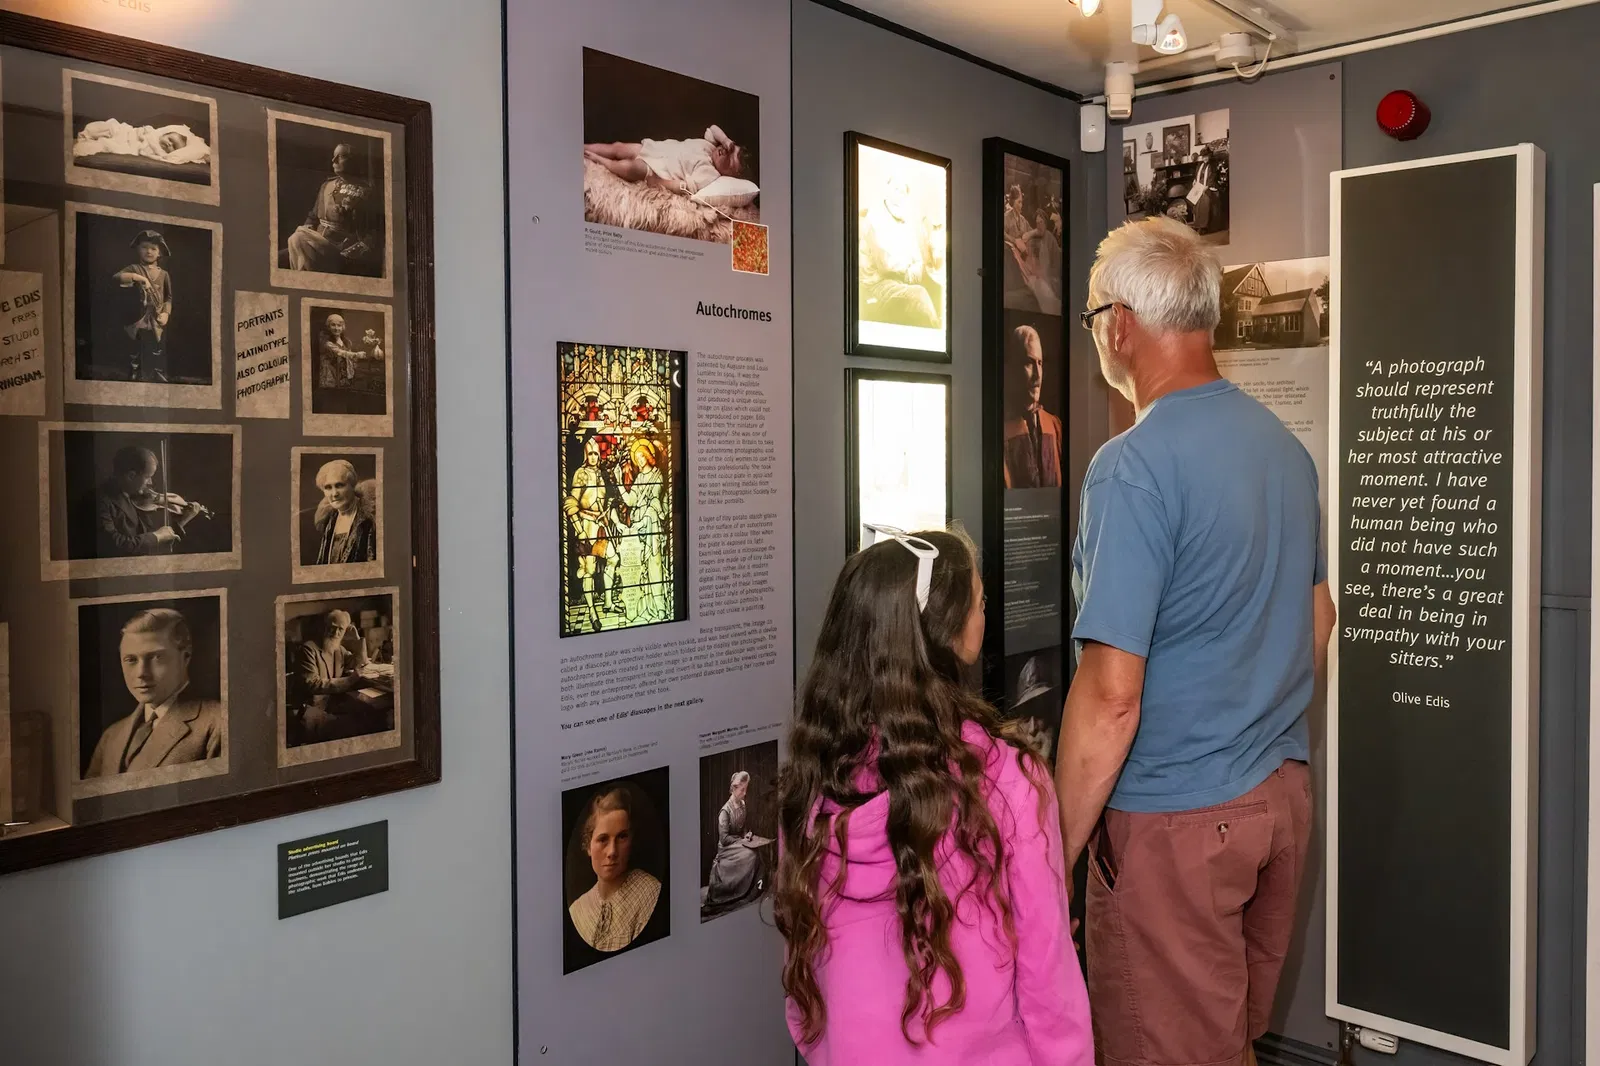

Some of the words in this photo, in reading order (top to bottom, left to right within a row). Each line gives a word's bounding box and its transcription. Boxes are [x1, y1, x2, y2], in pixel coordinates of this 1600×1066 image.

[14, 290, 41, 308] EDIS
[237, 308, 284, 332] PORTRAITS
[696, 301, 771, 322] Autochromes
[2, 328, 39, 345] STUDIO
[265, 328, 275, 337] IN
[237, 366, 256, 380] ALSO
[257, 355, 288, 373] COLOUR
[1388, 356, 1484, 378] photograph
[1356, 382, 1409, 397] should
[1416, 381, 1494, 399] represent
[1372, 404, 1443, 422] truthfully
[1450, 403, 1476, 418] the
[1358, 427, 1414, 444] subject
[1420, 428, 1436, 441] at
[1443, 426, 1466, 440] his
[1474, 430, 1492, 440] or
[1348, 449, 1373, 463] her
[1378, 451, 1417, 463] most
[1424, 449, 1502, 464] attractive
[1360, 473, 1427, 486] moment.
[1436, 472, 1441, 486] I
[1448, 472, 1487, 487] have
[1352, 497, 1395, 508] never
[1400, 496, 1425, 511] yet
[1431, 494, 1480, 512] found
[1487, 500, 1496, 510] a
[1351, 515, 1402, 530] human
[1410, 516, 1455, 536] being
[1464, 519, 1497, 534] who
[1351, 537, 1375, 551] did
[1381, 540, 1407, 553] not
[1414, 539, 1452, 555] have
[1458, 542, 1497, 557] such
[1361, 563, 1370, 573] a
[1345, 584, 1374, 598] see,
[1382, 582, 1435, 599] there’s
[1443, 590, 1452, 600] a
[1458, 591, 1504, 605] great
[1360, 603, 1392, 618] deal
[1398, 606, 1412, 620] in
[1420, 607, 1464, 628] being
[1472, 611, 1486, 626] in
[1344, 627, 1419, 646] sympathy
[1426, 631, 1459, 646] with
[1466, 638, 1505, 651] your
[1393, 692, 1420, 704] Olive
[1426, 696, 1449, 708] Edis
[561, 722, 571, 730] You
[630, 707, 655, 716] diascopes
[663, 702, 672, 710] the
[673, 700, 685, 708] next
[686, 697, 703, 708] gallery.
[303, 843, 325, 852] advertising
